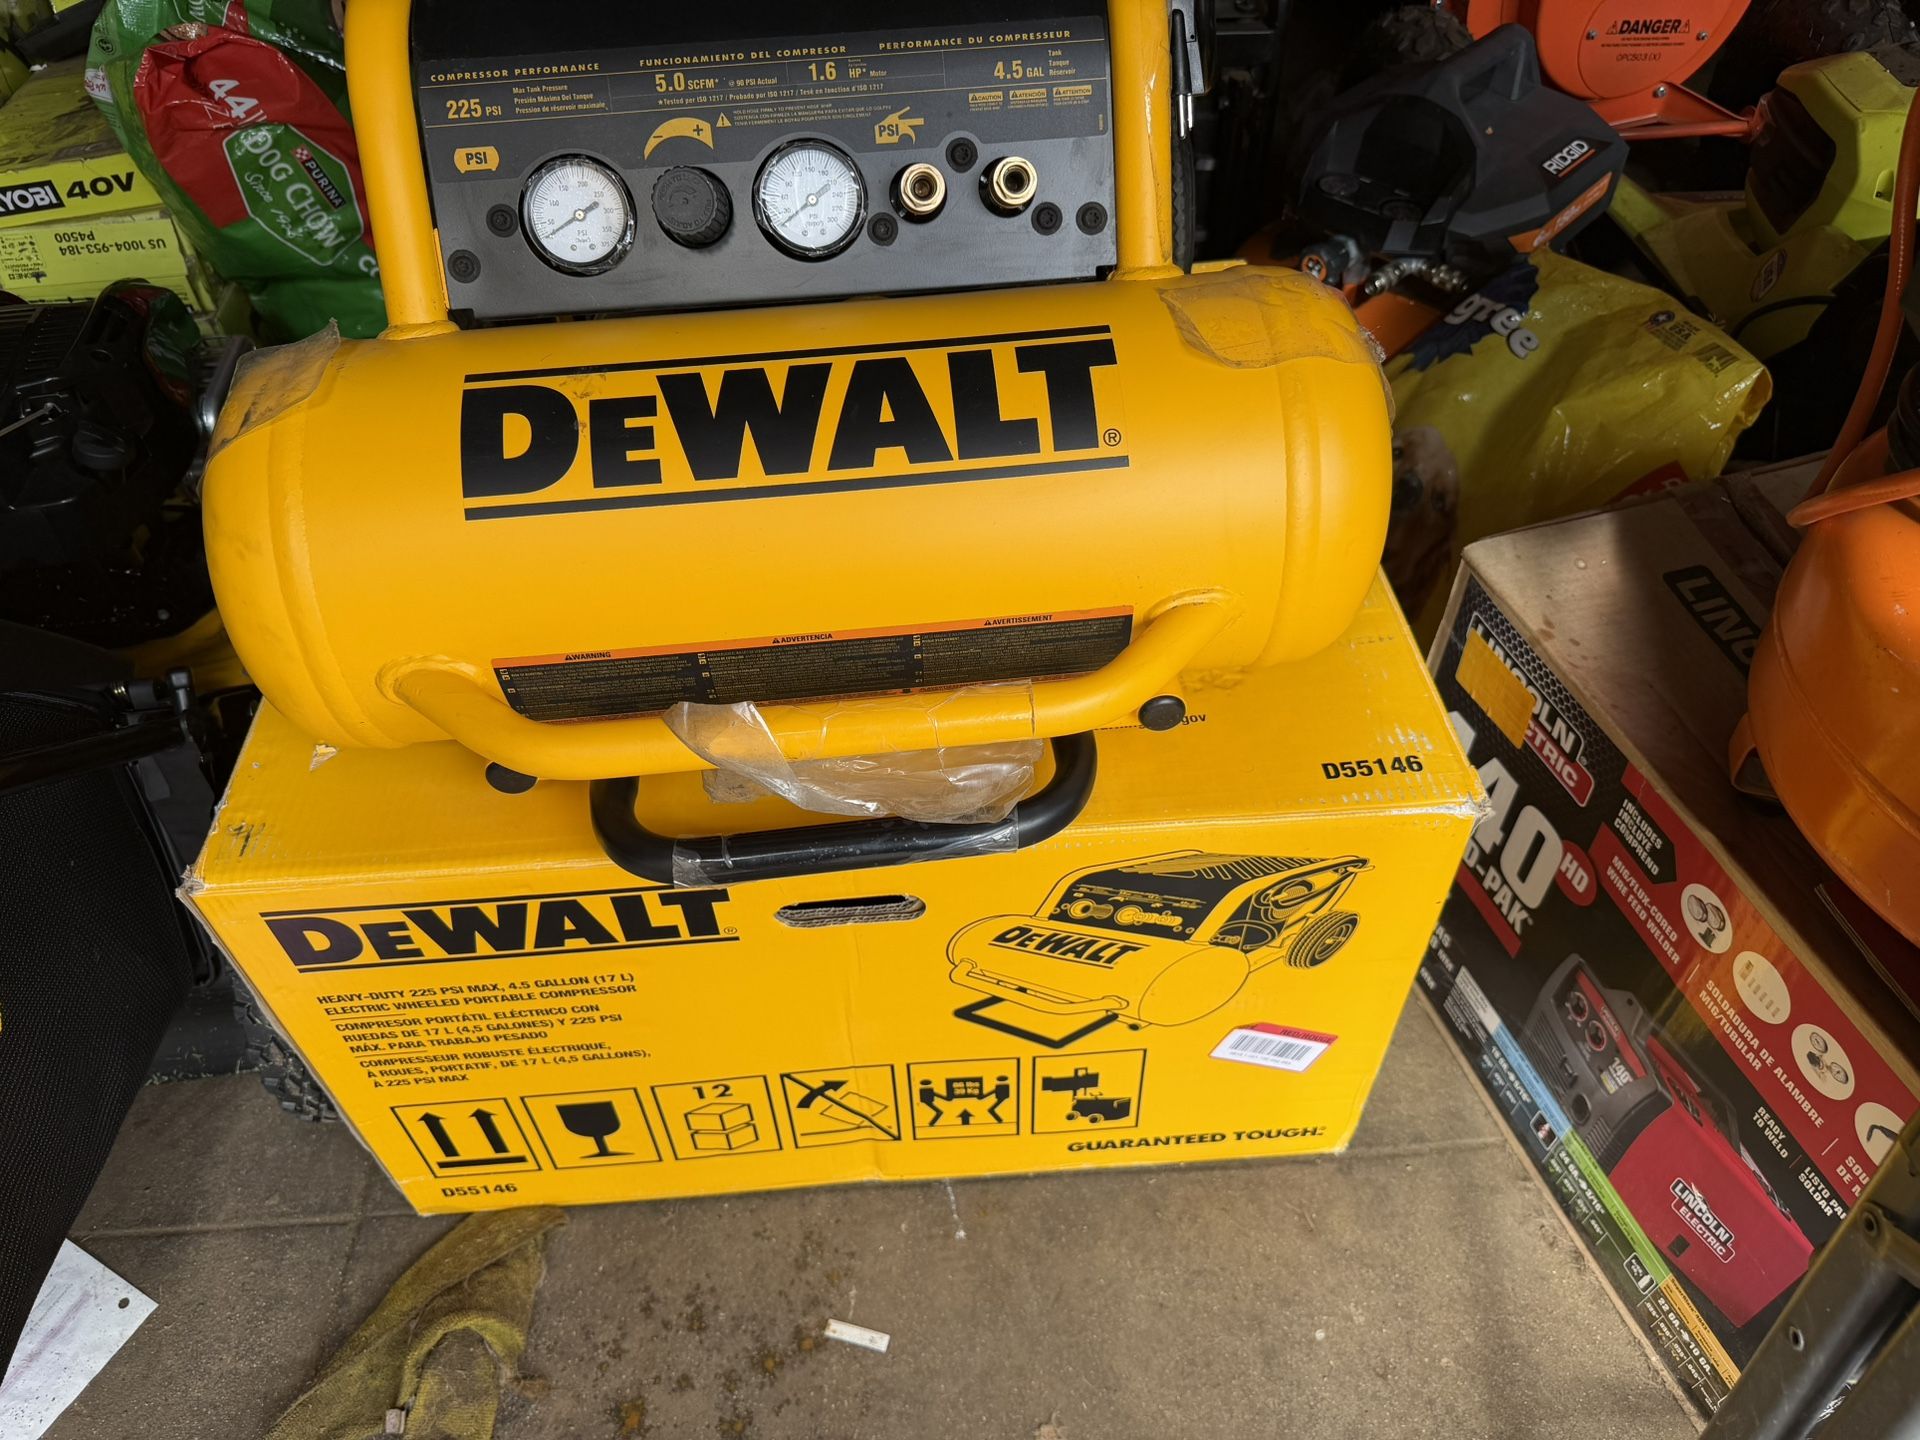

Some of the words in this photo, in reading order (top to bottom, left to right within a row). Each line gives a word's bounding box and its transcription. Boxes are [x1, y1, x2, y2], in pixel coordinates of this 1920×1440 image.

[1619, 19, 1682, 35] DANGER
[879, 37, 963, 51] PERFORMANCE
[968, 35, 983, 45] DU
[989, 30, 1071, 44] COMPRESSEUR
[1047, 49, 1062, 57] Tank
[639, 53, 745, 67] FUNCIONAMIENTO
[750, 51, 771, 60] DEL
[776, 45, 846, 58] COMPRESOR
[430, 70, 509, 83] COMPRESSOR
[514, 63, 600, 77] PERFORMANCE
[655, 72, 686, 93] 5.0
[736, 79, 745, 87] 90
[745, 78, 756, 86] PSI
[757, 77, 778, 86] Actual
[808, 61, 837, 81] 1.6
[870, 69, 887, 77] Motor
[993, 60, 1023, 80] 4.5
[1026, 67, 1045, 78] GAL
[1049, 68, 1076, 76] Réservoir
[512, 87, 526, 95] Max
[526, 86, 541, 94] Tank
[542, 84, 568, 93] Pressure
[561, 94, 572, 102] Del
[572, 92, 593, 102] Tanque
[696, 95, 707, 103] ISO
[709, 94, 724, 102] 1217
[729, 91, 755, 101] Probado
[755, 92, 766, 101] por
[767, 91, 778, 99] ISO
[779, 90, 794, 98] 1217
[869, 83, 884, 91] 1217
[446, 99, 482, 120] 225
[486, 105, 502, 117] PSI
[515, 106, 541, 115] Pression
[878, 124, 900, 137] PSI
[465, 151, 488, 166] PSI
[1542, 141, 1589, 175] RIDGID
[66, 171, 135, 199] 40V
[244, 131, 293, 181] DOG
[285, 183, 345, 248] CHOW
[305, 160, 342, 208] PURINA
[54, 230, 96, 243] P4500
[59, 240, 146, 256] 1004-953-184
[148, 238, 167, 250] US
[460, 338, 1119, 499] DEWALT
[992, 614, 1053, 626] AVERTISSEMENT
[781, 633, 833, 644] ADVERTENCIA
[571, 650, 612, 661] WARNING
[1321, 754, 1424, 780] D55146
[1618, 808, 1653, 852] INCLUYE
[1622, 799, 1663, 850] INCLUDES
[1614, 817, 1660, 876] COMPREND
[1560, 851, 1590, 894] HD
[1612, 855, 1678, 942] MIG/FLUX-CORED
[265, 888, 730, 966] DEWALT
[1606, 866, 1629, 897] WIRE
[1627, 894, 1648, 921] FEED
[1646, 919, 1681, 965] WELDER
[997, 925, 1144, 968] DEWALT
[316, 990, 405, 1005] HEAVY-DUTY
[409, 988, 437, 997] 225
[440, 986, 464, 995] PSI
[467, 983, 506, 993] MAX,
[508, 980, 531, 991] 4.5
[534, 976, 590, 988] GALLON
[593, 974, 616, 985] (17
[620, 973, 635, 983] L)
[324, 1003, 391, 1016] ELECTRIC
[392, 997, 460, 1011] WHEELED
[463, 992, 537, 1005] PORTABLE
[539, 984, 637, 999] COMPRESSOR
[335, 1017, 423, 1032] COMPRESOR
[425, 1012, 491, 1025] PORTÁTIL
[494, 1006, 568, 1020] ELÉCTRICO
[571, 1004, 601, 1013] CON
[342, 1032, 398, 1043] RUEDAS
[401, 1029, 421, 1038] DE
[424, 1028, 440, 1036] 17
[444, 1027, 454, 1035] L
[456, 1025, 483, 1035] (4,5
[486, 1019, 554, 1032] GALONES)
[557, 1018, 566, 1026] Y
[570, 1016, 596, 1025] 225
[600, 1014, 623, 1023] PSI
[1699, 990, 1763, 1072] MIG/TUBULAR
[349, 1042, 386, 1054] MÁX.
[389, 1040, 426, 1050] PARA
[428, 1035, 490, 1047] TRABAJO
[493, 1031, 548, 1042] PESADO
[359, 1053, 460, 1068] COMPRESSEUR
[463, 1048, 525, 1060] ROBUSTE
[528, 1041, 612, 1055] ÉLECTRIQUE,
[1706, 980, 1760, 1050] SOLDADURA
[1759, 1048, 1775, 1067] DE
[1773, 1067, 1825, 1129] ALAMBRE
[379, 1066, 429, 1077] ROUES,
[430, 1061, 498, 1074] PORTATIF,
[500, 1059, 519, 1068] DE
[522, 1057, 539, 1066] 17
[542, 1056, 551, 1065] L
[554, 1055, 579, 1065] (4,5
[582, 1049, 652, 1062] GALLONS),
[385, 1078, 411, 1087] 225
[414, 1076, 437, 1085] PSI
[439, 1074, 470, 1083] MAX
[692, 1082, 736, 1100] 12
[1752, 1112, 1765, 1128] TO
[1764, 1127, 1789, 1159] WELD
[1757, 1106, 1787, 1141] READY
[1067, 1132, 1227, 1152] GUARANTEED
[1803, 1166, 1831, 1199] LISTO
[1836, 1164, 1853, 1185] DE
[440, 1181, 519, 1199] D55146
[1798, 1172, 1834, 1217] SOLDAR
[1674, 1182, 1731, 1242] LINCOLN
[1679, 1205, 1727, 1256] ELECTRIC
[1657, 1297, 1670, 1312] 22
[1689, 1342, 1701, 1357] 10
